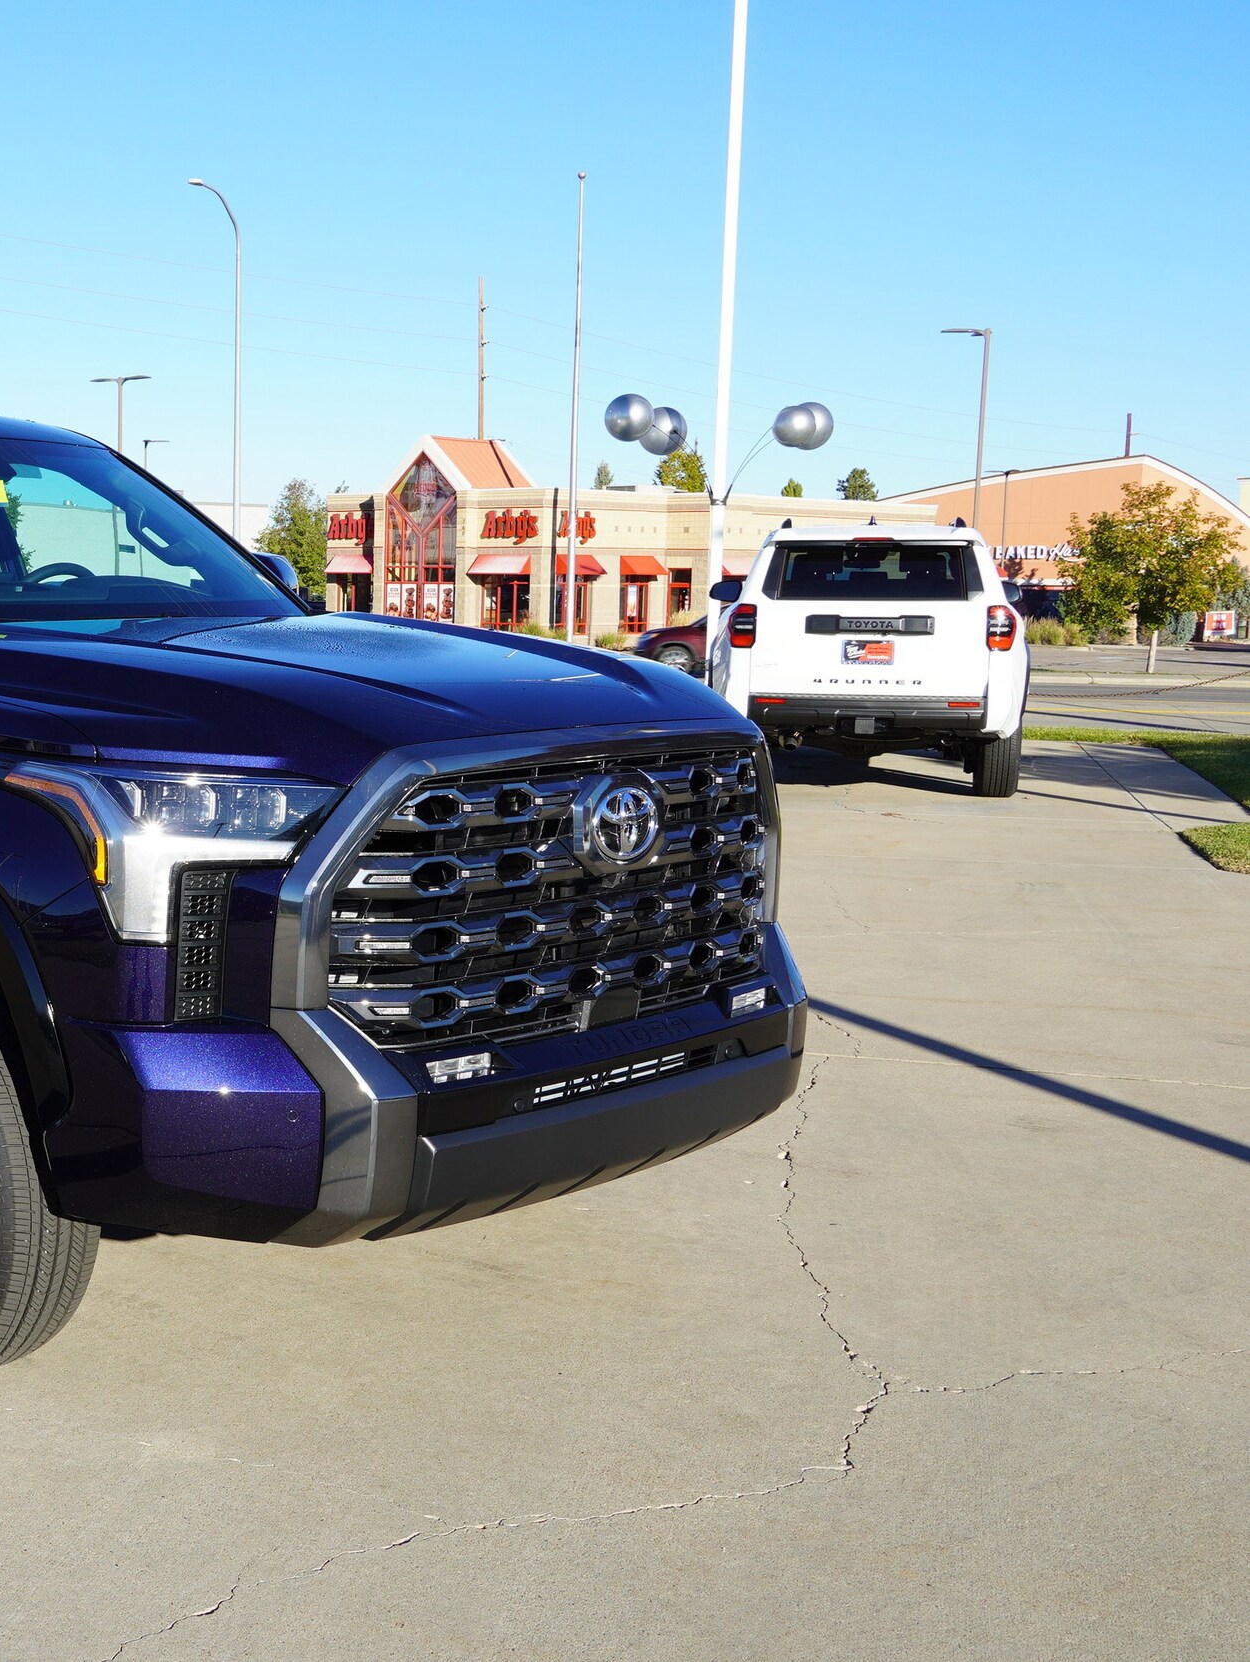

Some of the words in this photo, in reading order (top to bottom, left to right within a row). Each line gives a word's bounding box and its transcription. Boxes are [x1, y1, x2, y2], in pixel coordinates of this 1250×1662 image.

[480, 509, 539, 545] Arby's
[847, 620, 894, 629] TOYOTA
[562, 1015, 692, 1058] TUNDRA
